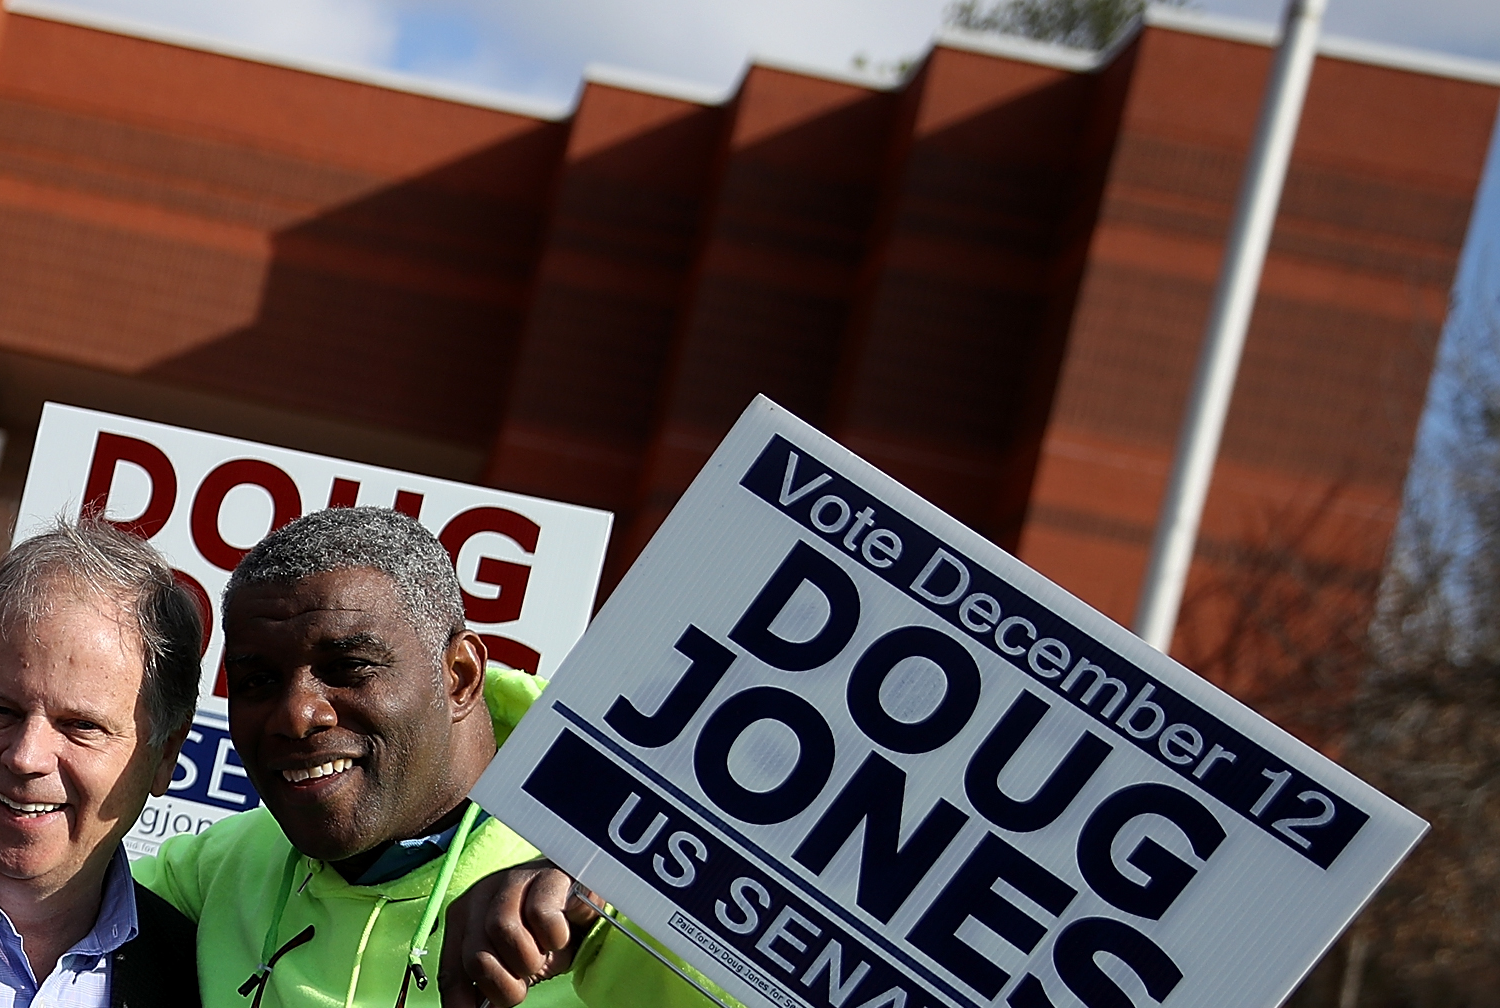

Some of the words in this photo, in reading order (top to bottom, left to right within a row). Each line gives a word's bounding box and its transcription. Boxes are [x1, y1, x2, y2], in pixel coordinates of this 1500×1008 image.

[80, 429, 542, 625] DOG
[729, 540, 1228, 921] DOUG
[779, 451, 903, 568] Vote
[910, 548, 1238, 779] December
[1250, 768, 1335, 850] 12
[608, 792, 708, 888] US
[675, 918, 694, 936] Paid
[695, 932, 708, 947] for
[708, 943, 721, 957] by
[721, 950, 744, 973] Doug
[744, 969, 770, 992] Jones
[769, 988, 784, 1003] for
